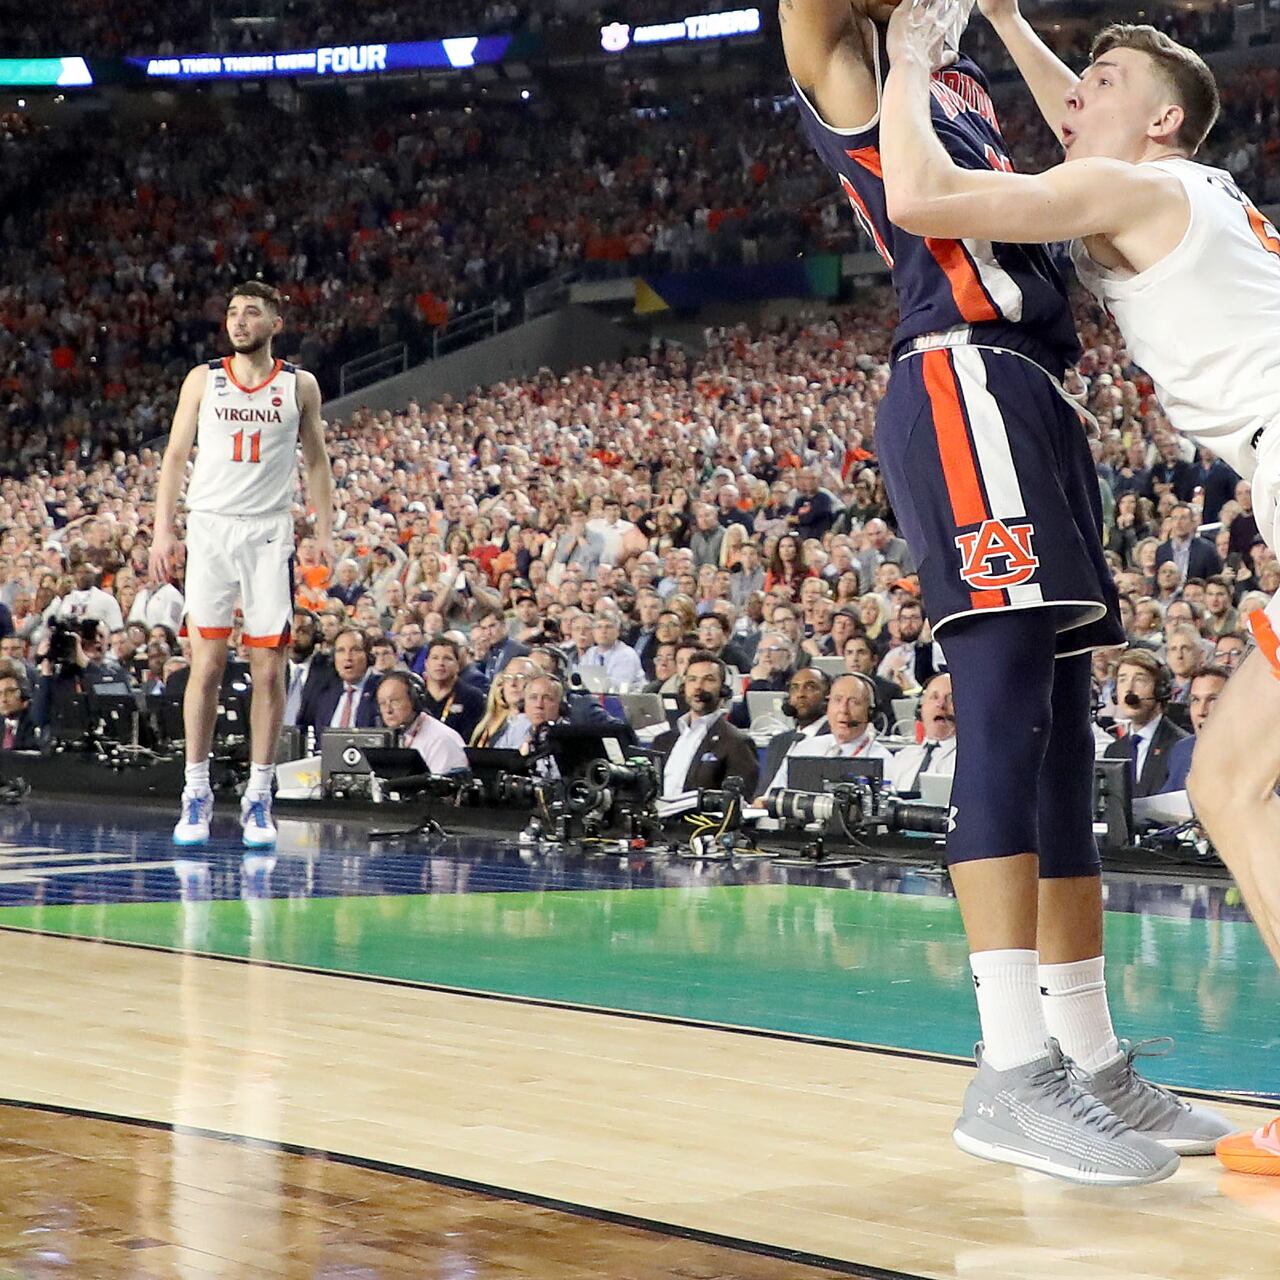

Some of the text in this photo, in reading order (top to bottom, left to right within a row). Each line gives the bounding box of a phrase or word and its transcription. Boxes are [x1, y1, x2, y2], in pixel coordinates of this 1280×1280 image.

[147, 59, 180, 75] AND
[181, 57, 222, 74] THEN
[317, 44, 387, 73] FOUR
[214, 407, 283, 424] VIRGINIA
[229, 427, 263, 464] 11
